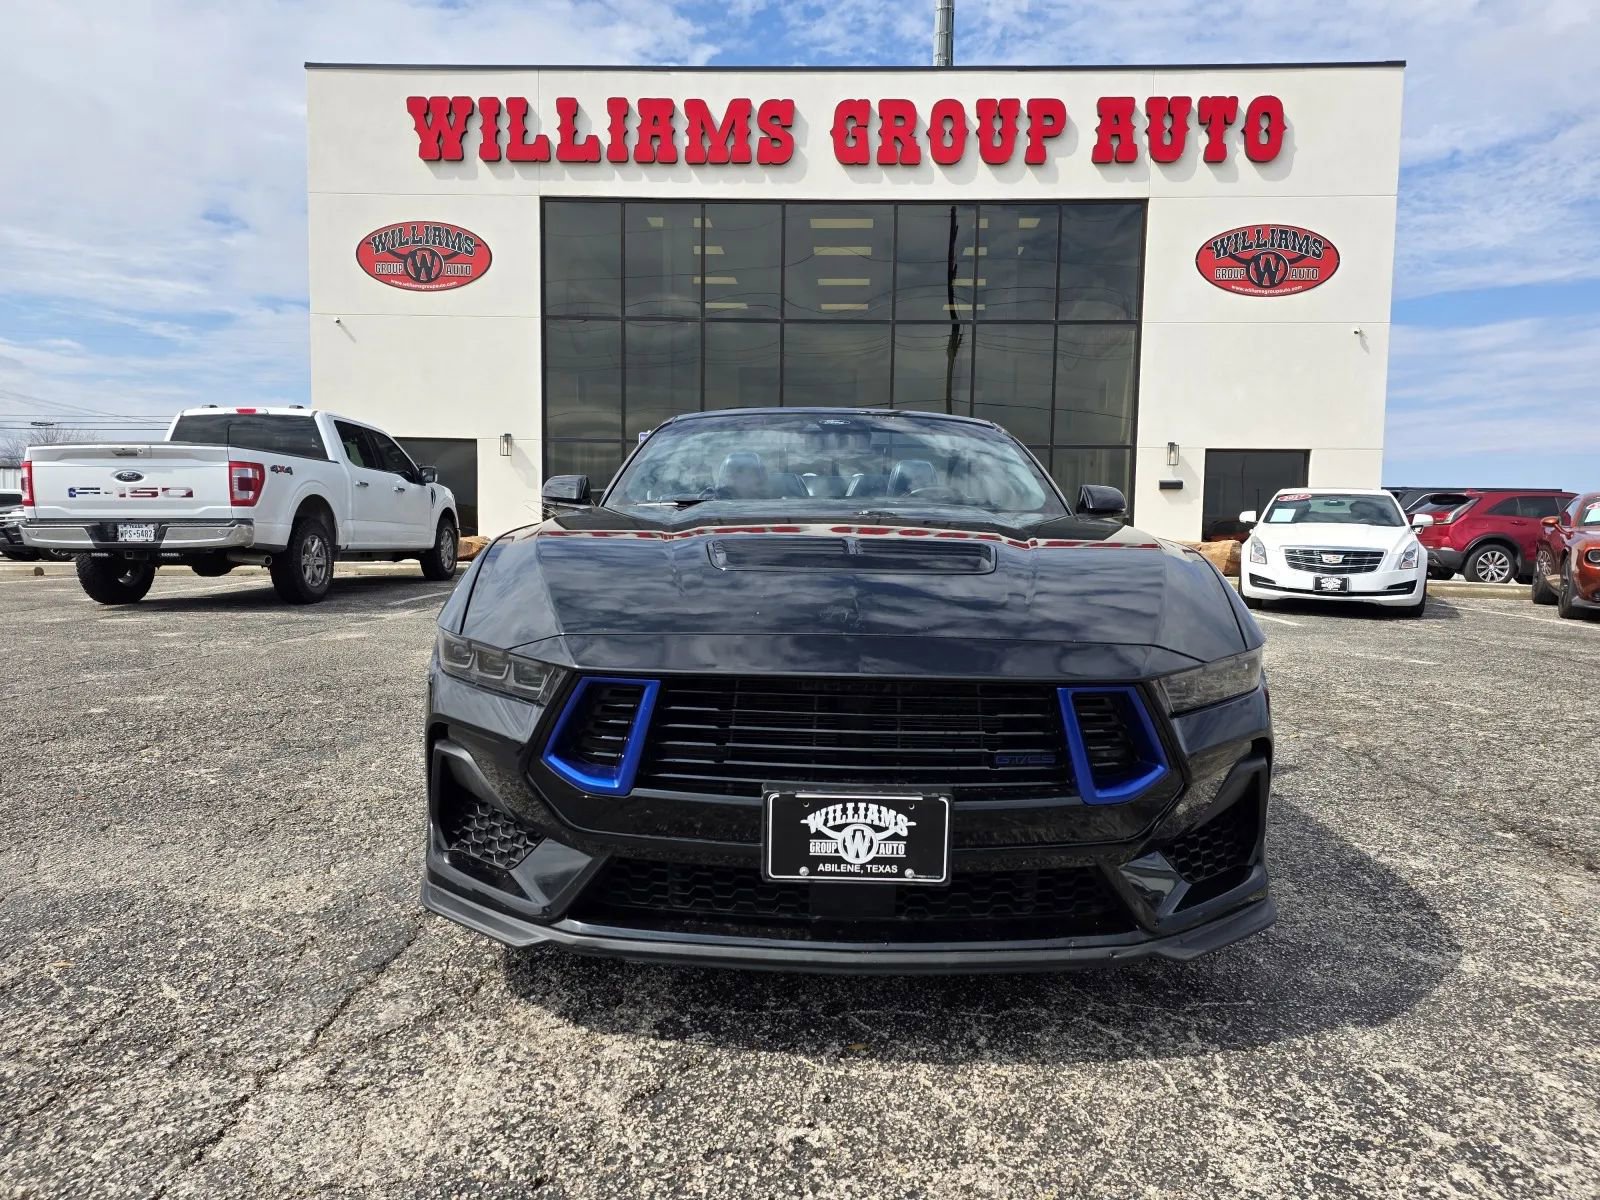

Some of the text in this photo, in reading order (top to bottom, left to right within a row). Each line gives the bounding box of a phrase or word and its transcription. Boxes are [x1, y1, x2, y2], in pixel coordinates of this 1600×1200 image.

[406, 95, 1288, 166] WILLIAMS GROUP AUTO
[372, 225, 475, 256] WILLIAMS
[1212, 228, 1324, 260] WILLIAMS
[375, 262, 404, 275] GROUP
[446, 263, 472, 276] AUTO
[1215, 268, 1246, 280] GROUP
[1291, 268, 1319, 280] AUTO
[67, 487, 194, 498] F-150
[806, 802, 909, 837] WILLIAMS
[809, 841, 838, 854] GROUP
[879, 843, 905, 856] AUTO
[817, 863, 898, 874] ABILENE, TEXAS
